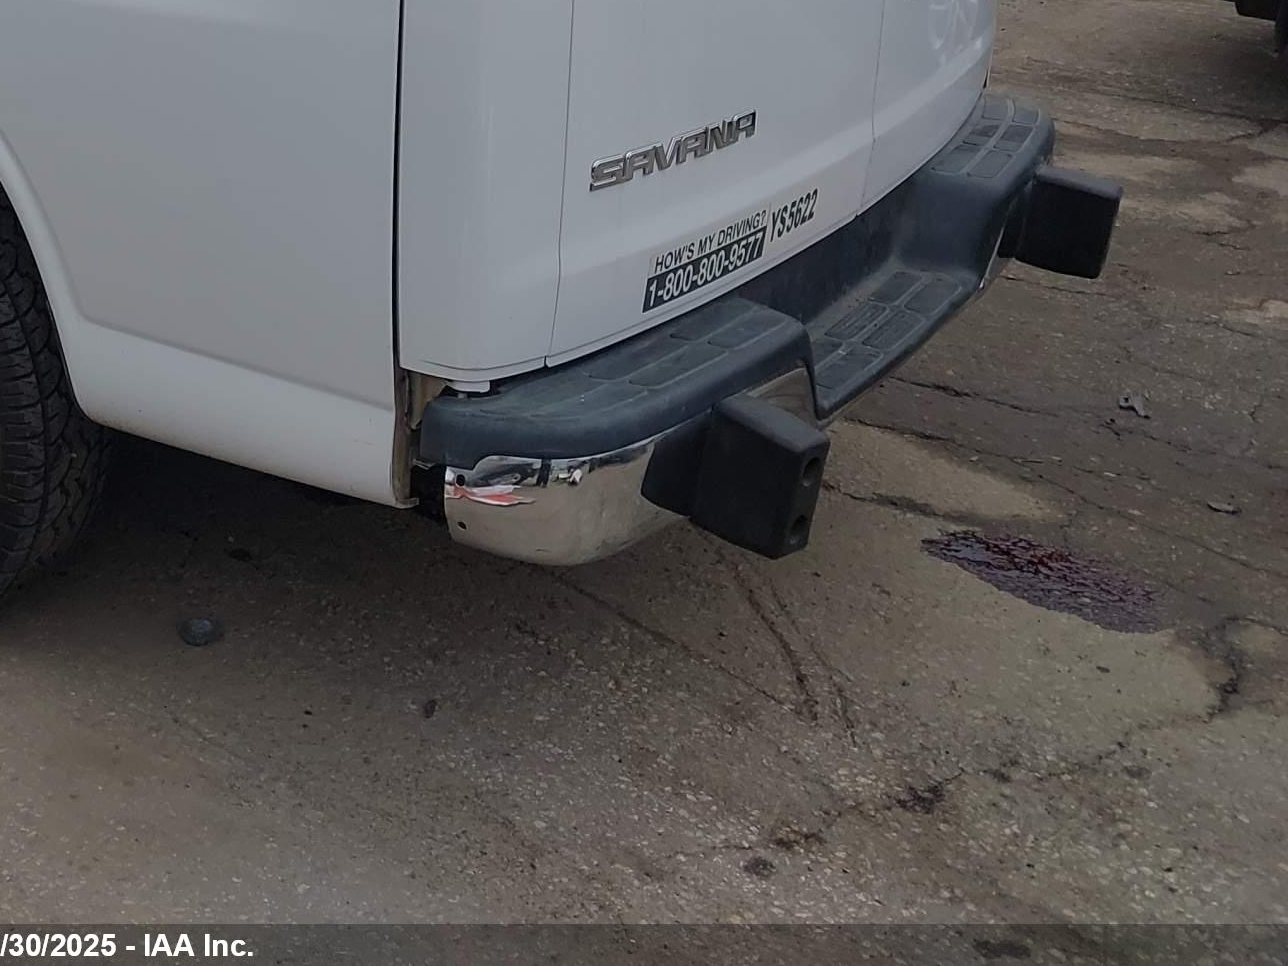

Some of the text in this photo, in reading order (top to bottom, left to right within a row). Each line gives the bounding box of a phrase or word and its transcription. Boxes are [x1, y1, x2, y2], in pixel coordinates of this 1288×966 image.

[589, 109, 757, 192] SAVANA
[649, 232, 764, 307] 1-800-800-9577
[654, 210, 766, 274] HOW'S MY DRIVING?
